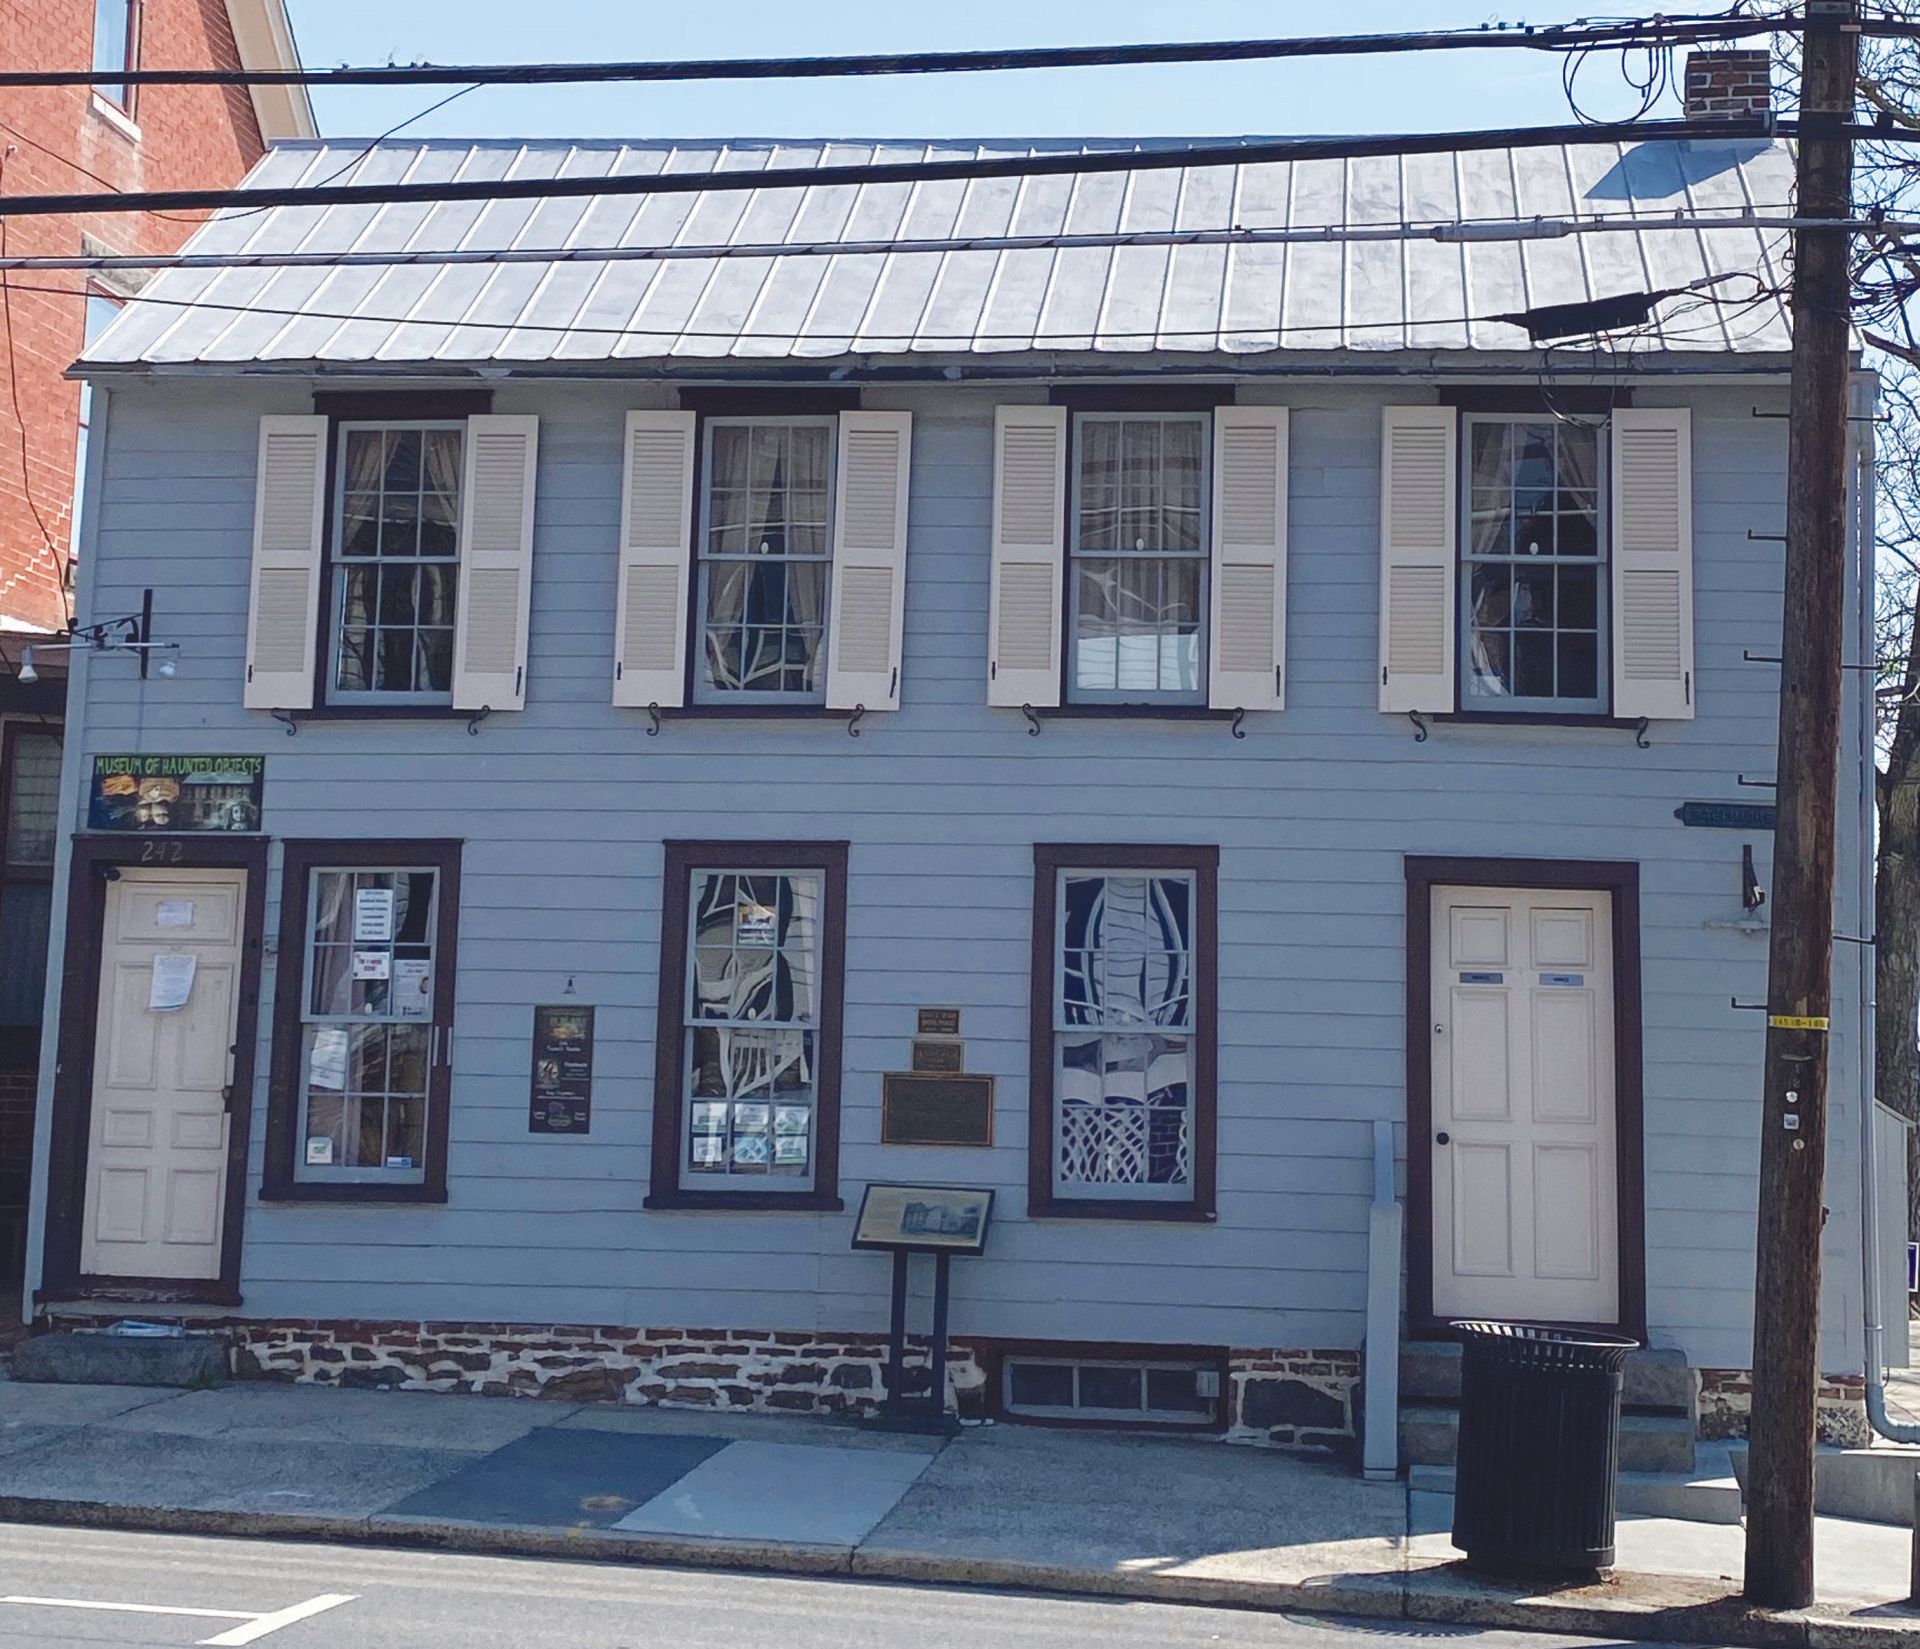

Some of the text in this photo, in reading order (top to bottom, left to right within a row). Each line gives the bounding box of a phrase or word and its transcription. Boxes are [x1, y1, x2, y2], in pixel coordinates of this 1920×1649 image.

[95, 757, 262, 775] MUSEUM OF HAUNTED OBJECTS
[141, 840, 184, 862] 242
